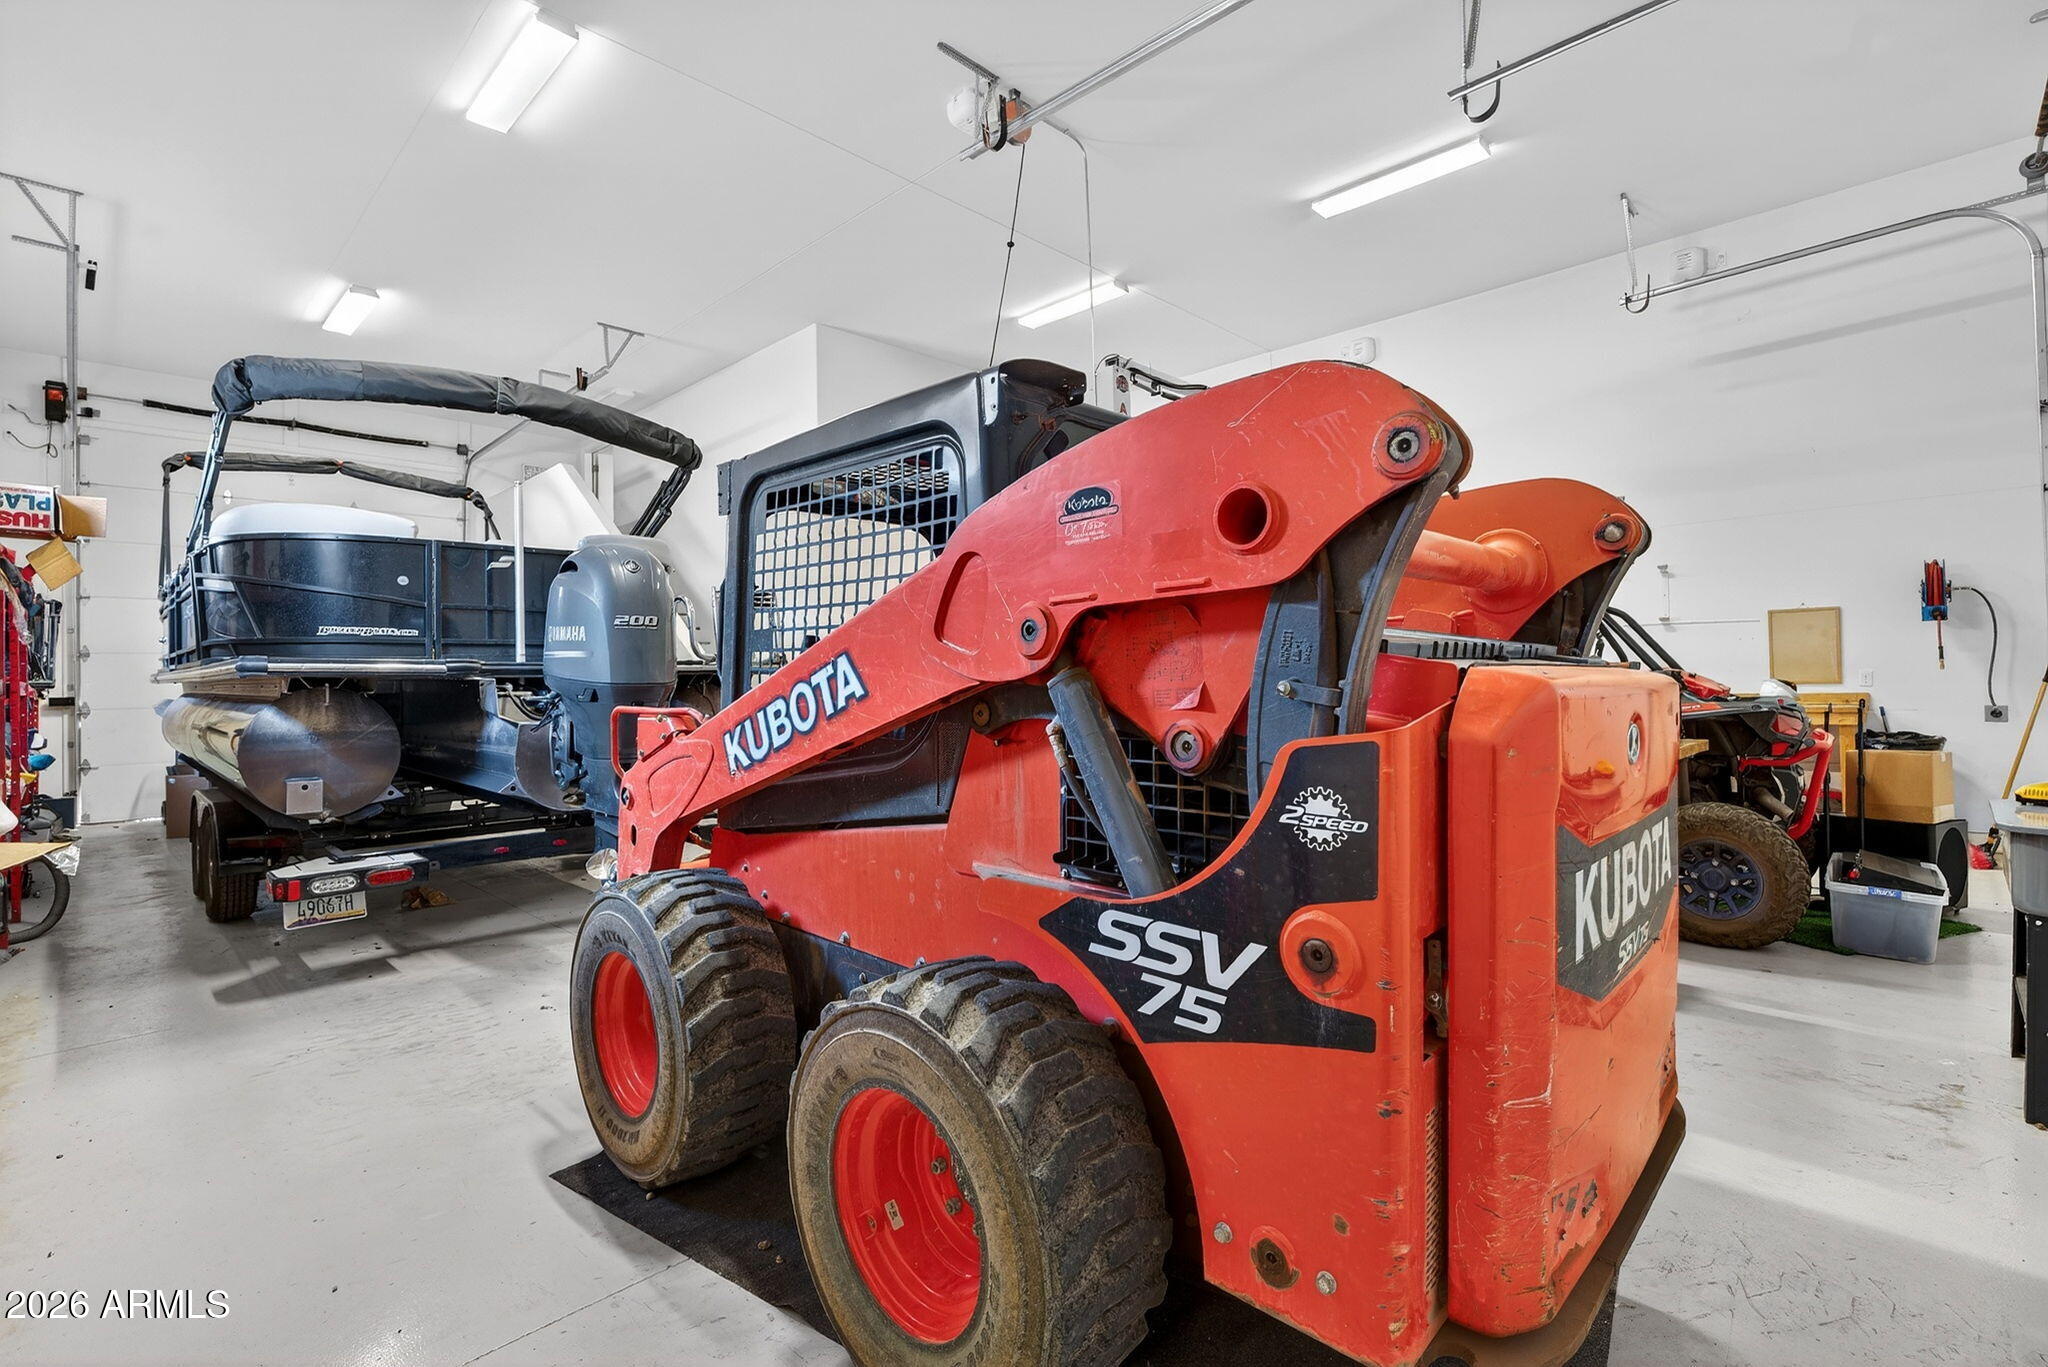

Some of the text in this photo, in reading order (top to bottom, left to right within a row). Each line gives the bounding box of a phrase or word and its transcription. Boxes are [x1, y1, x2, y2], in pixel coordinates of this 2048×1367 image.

[0, 492, 51, 511] PLA
[547, 625, 586, 642] YAMAHA
[614, 615, 658, 627] 200
[723, 651, 869, 775] KUBOTA
[298, 894, 354, 918] 49067H
[1575, 816, 1672, 964] KUBOTA
[1088, 909, 1268, 991] SSV
[1137, 972, 1228, 1035] 75
